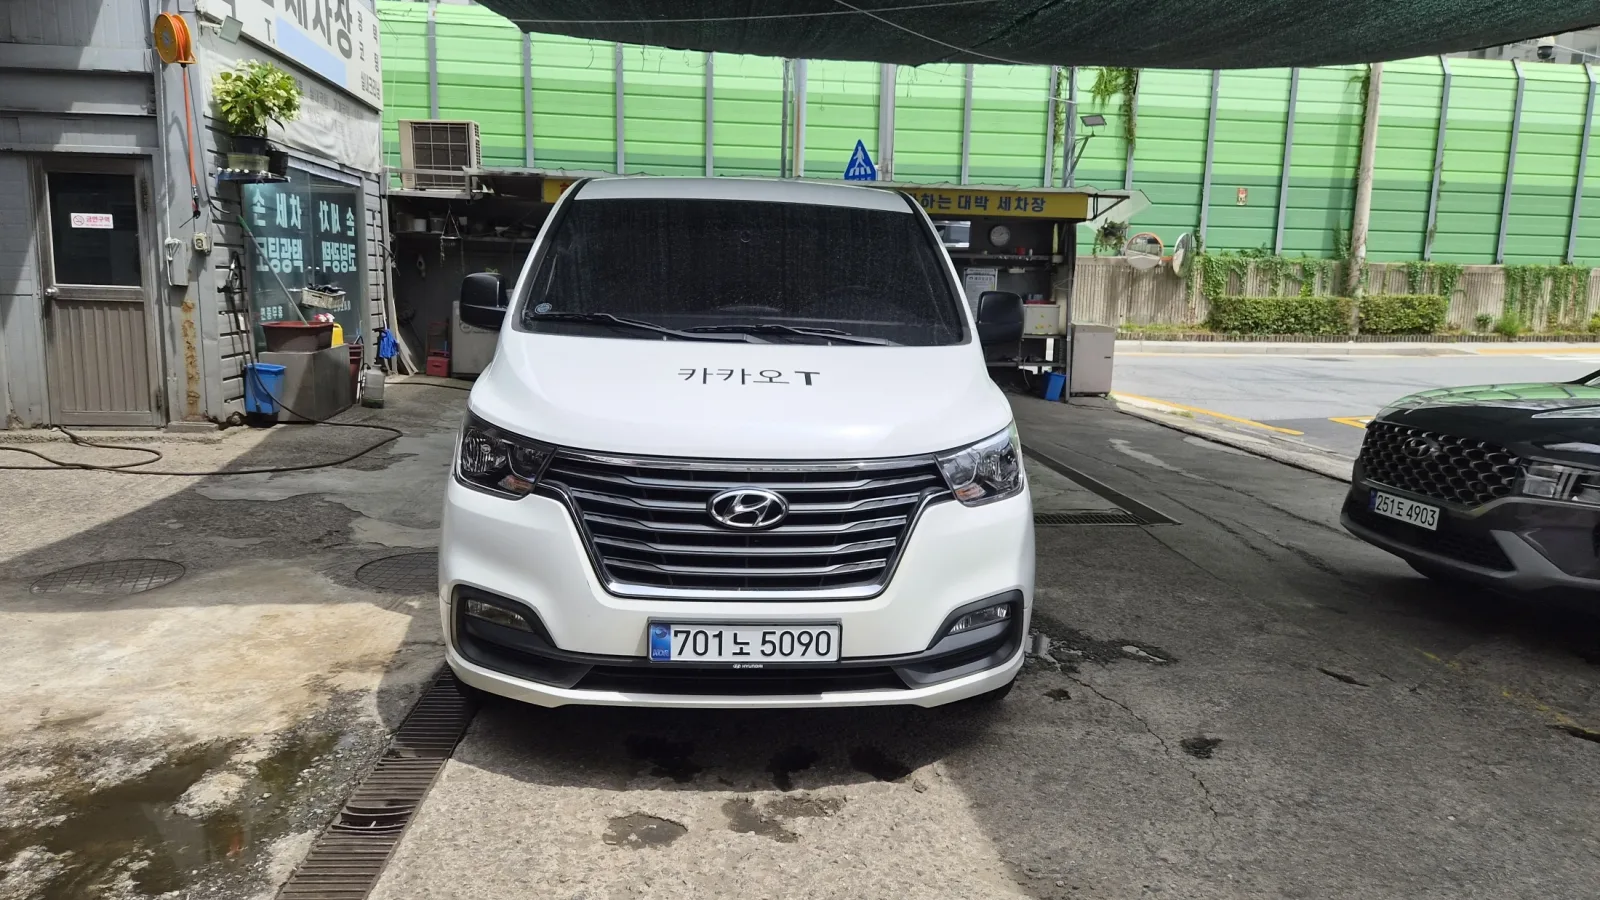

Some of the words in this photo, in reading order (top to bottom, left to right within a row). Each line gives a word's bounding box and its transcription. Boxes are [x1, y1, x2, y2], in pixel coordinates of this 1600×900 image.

[252, 189, 267, 227] 손
[275, 192, 302, 230] 세차
[957, 195, 990, 211] 대박
[997, 196, 1045, 212] 세차장
[677, 367, 790, 386] 카카오
[1376, 495, 1404, 517] 251도
[1406, 503, 1437, 527] 4903
[673, 630, 751, 657] 701노
[760, 630, 832, 657] 5090
